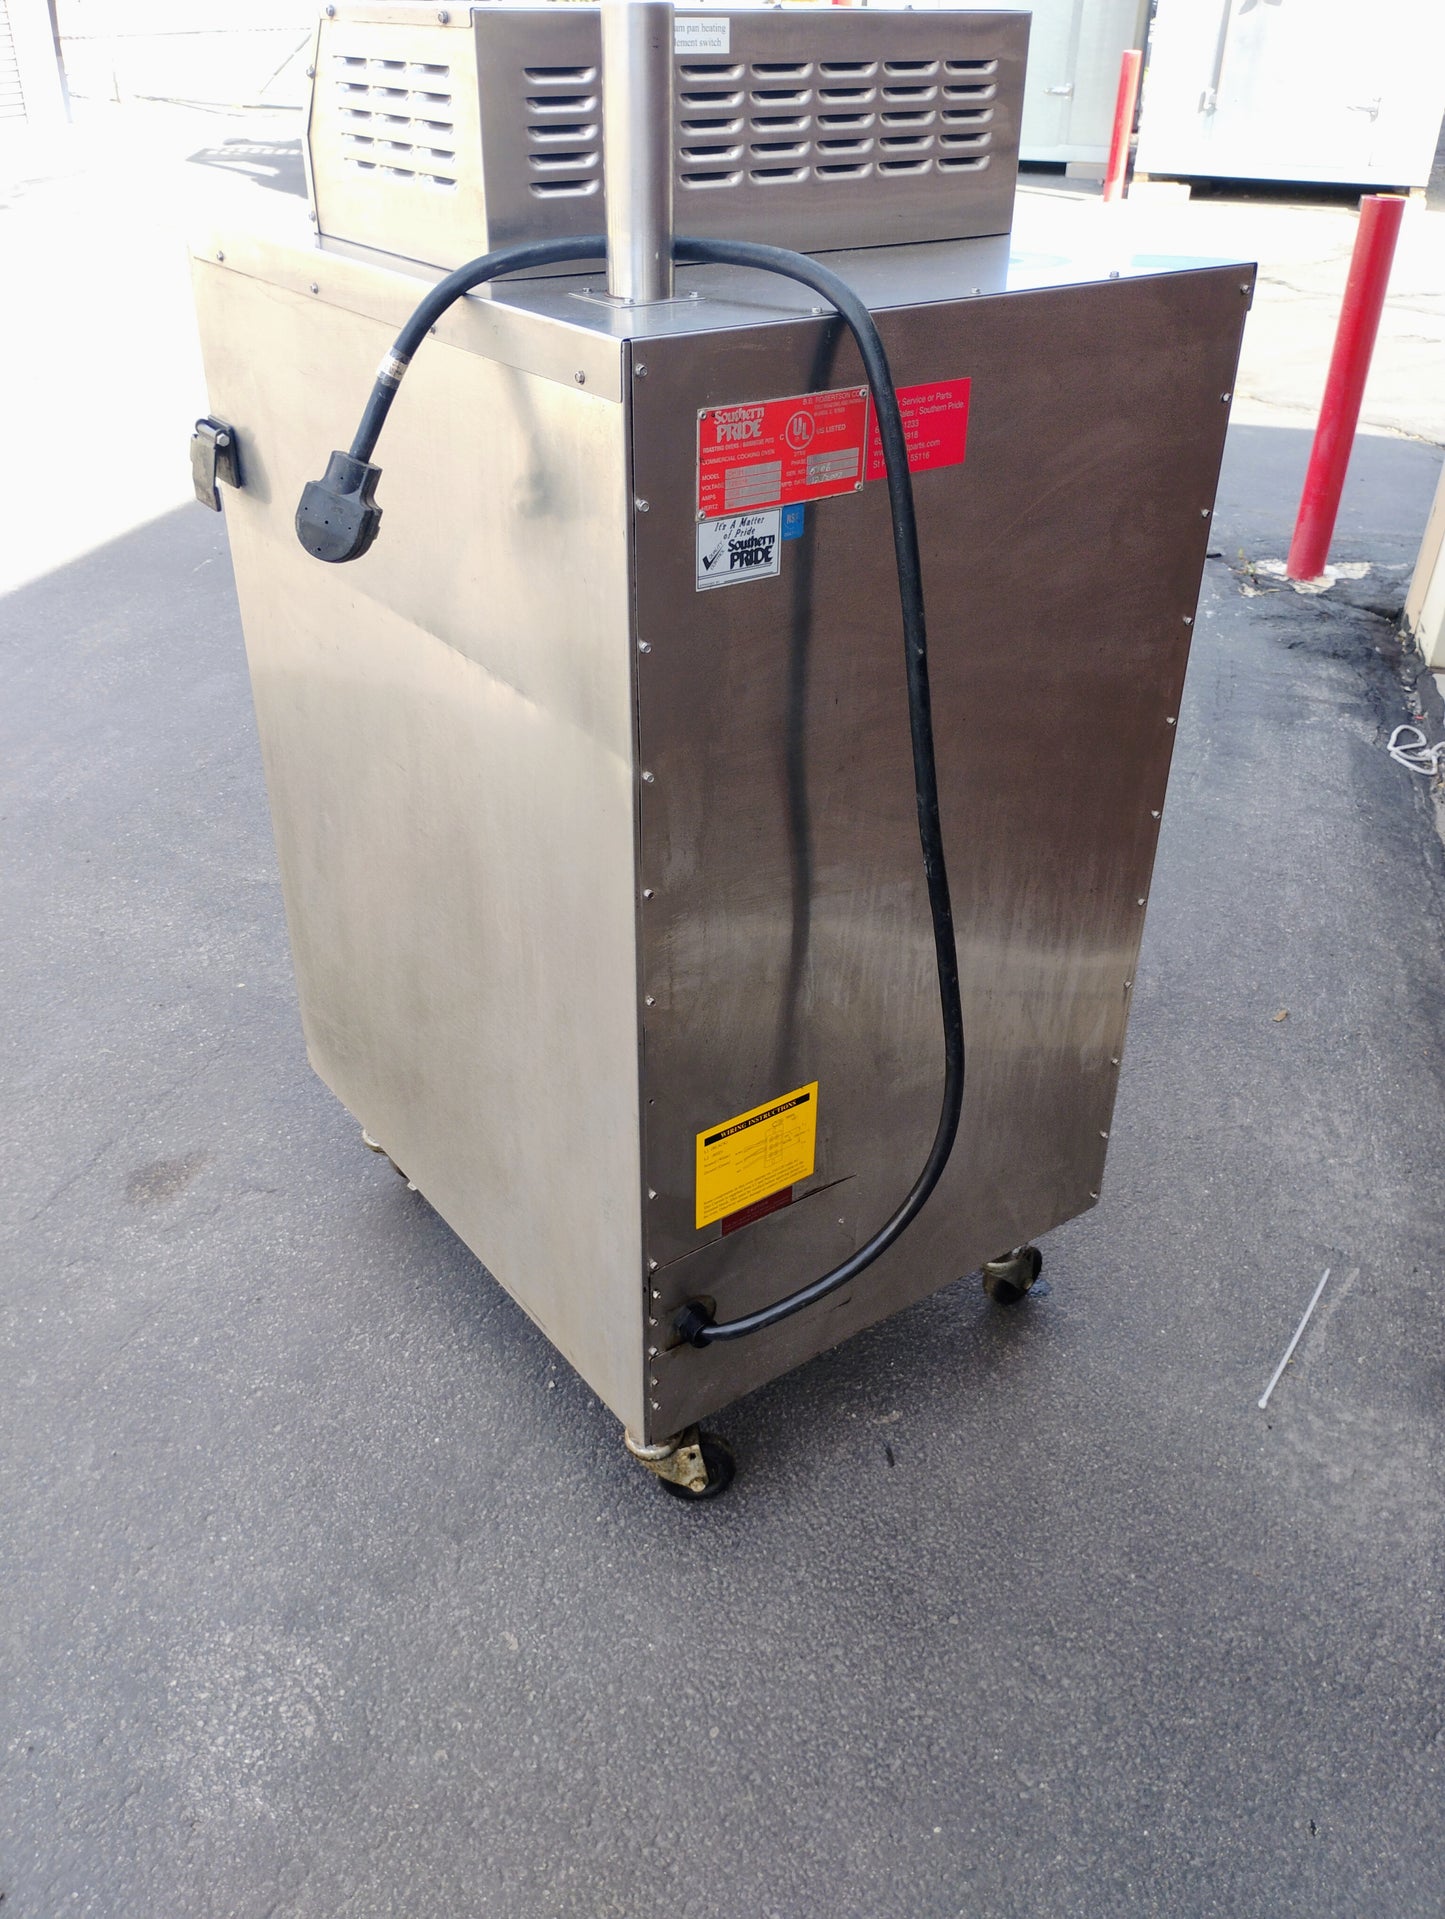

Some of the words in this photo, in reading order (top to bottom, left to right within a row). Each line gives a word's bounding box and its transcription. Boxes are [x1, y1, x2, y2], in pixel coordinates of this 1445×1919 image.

[687, 25, 699, 34] pan
[702, 23, 726, 34] heating
[699, 37, 721, 47] switch
[815, 392, 850, 403] ROBERTSON
[902, 396, 926, 406] Service
[927, 394, 934, 402] or
[936, 392, 952, 400] Parts
[919, 403, 947, 415] Southern
[948, 401, 965, 410] Pride
[714, 407, 764, 424] Southern
[717, 419, 763, 443] PRIDE
[826, 423, 846, 433] LISTED
[702, 455, 736, 465] COMMERCIAL
[737, 451, 760, 460] COOKING
[702, 473, 720, 481] MODEL
[714, 522, 727, 532] It's
[730, 520, 736, 530] A
[739, 517, 765, 528] Matter
[723, 530, 732, 540] of
[735, 527, 756, 539] Pride
[728, 535, 775, 552] Southern
[730, 545, 773, 570] PRIDE
[720, 1122, 747, 1138] WIRING
[748, 1100, 797, 1126] INSTRUCTIONS
